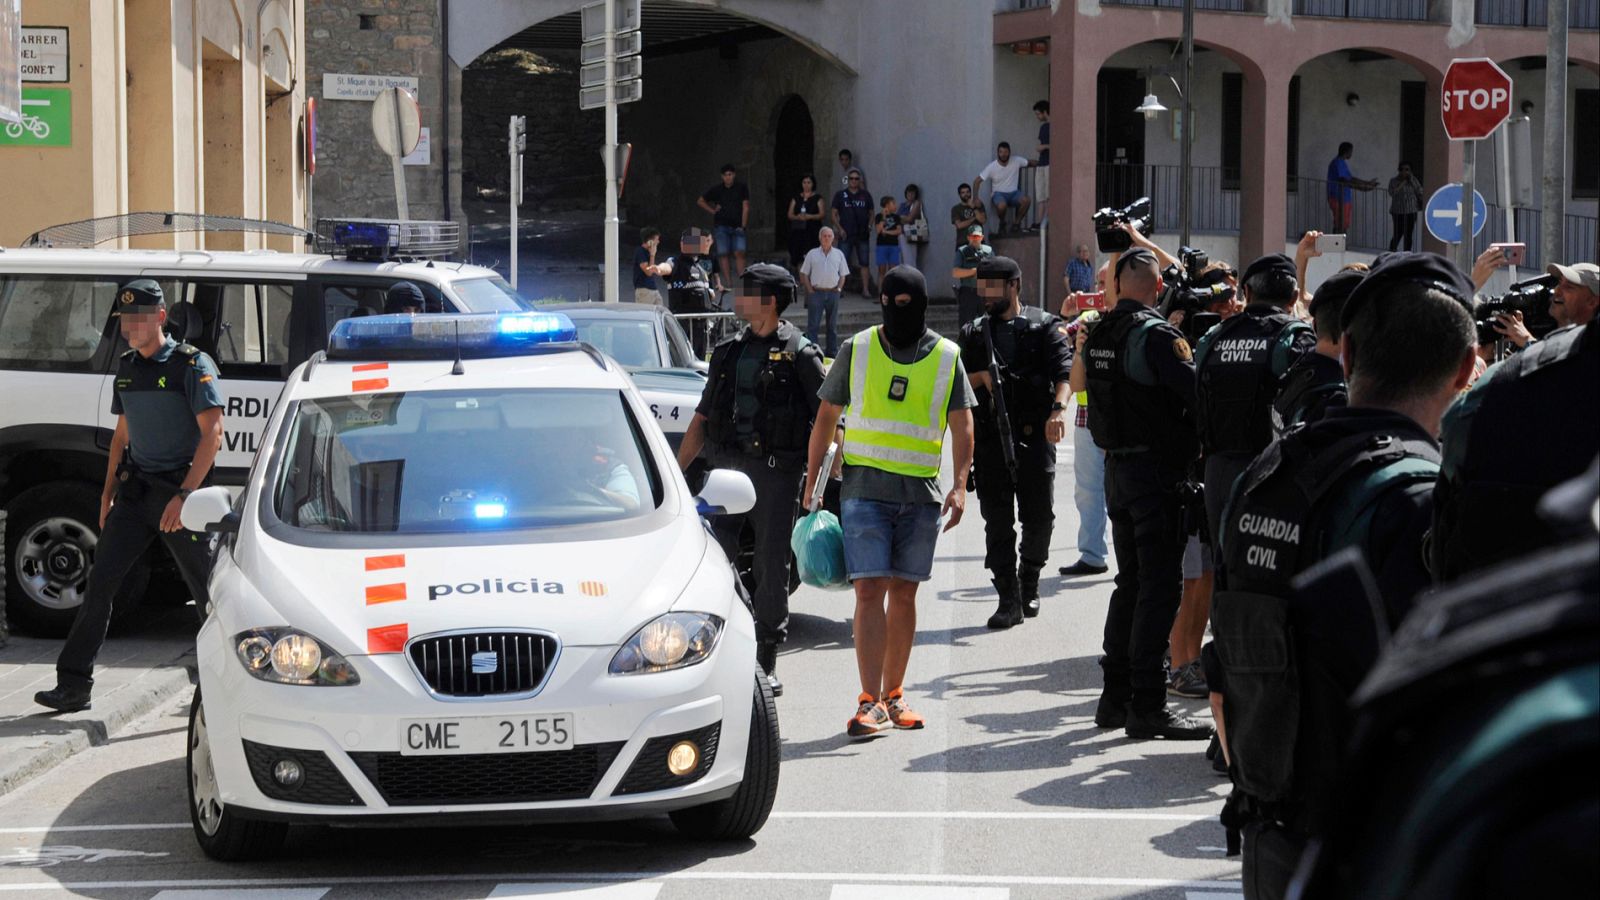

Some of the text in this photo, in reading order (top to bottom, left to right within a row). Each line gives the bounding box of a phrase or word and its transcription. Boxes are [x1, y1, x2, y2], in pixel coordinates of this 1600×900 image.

[20, 34, 58, 45] ARRER
[20, 49, 37, 59] EL
[20, 64, 56, 75] GONET
[368, 79, 376, 87] de
[378, 79, 384, 87] la
[1443, 88, 1508, 112] STOP
[1214, 339, 1268, 351] GUARDIA
[1089, 348, 1116, 360] GUARDIA
[1220, 350, 1253, 362] CIVIL
[1094, 361, 1110, 370] CIVIL
[221, 396, 269, 419] RDI
[670, 406, 679, 420] 4
[219, 431, 258, 452] VIL
[1239, 513, 1300, 545] GUARDIA
[1246, 545, 1277, 571] CIVIL
[428, 578, 564, 600] policia
[407, 718, 569, 750] CME 2155
